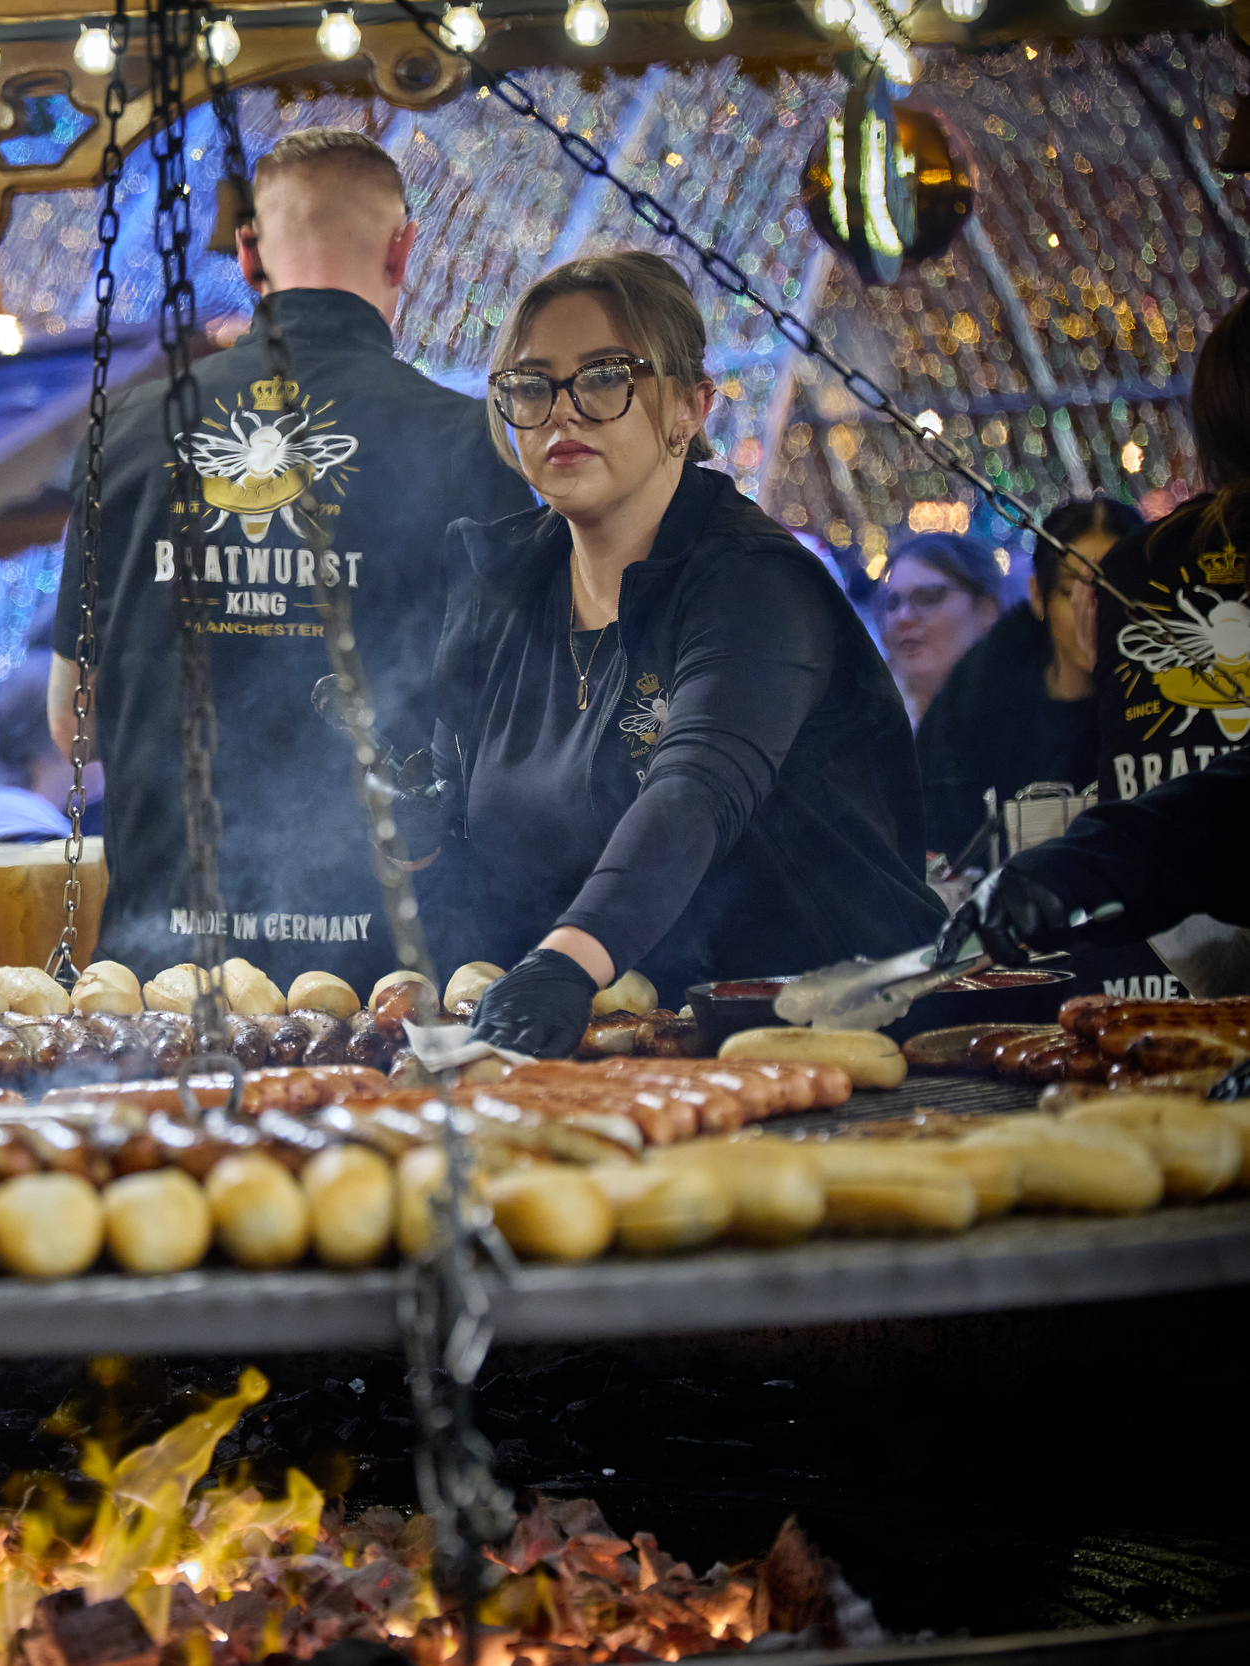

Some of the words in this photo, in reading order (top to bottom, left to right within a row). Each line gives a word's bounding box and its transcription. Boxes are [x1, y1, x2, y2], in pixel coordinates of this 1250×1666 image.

[225, 591, 287, 617] KING
[1125, 700, 1161, 721] SINCE
[630, 745, 650, 759] SINCE
[1112, 745, 1243, 801] BRAT
[169, 907, 228, 935] MADE
[233, 912, 258, 940] IN
[263, 913, 372, 943] GERMANY
[1102, 973, 1180, 1000] MADE
